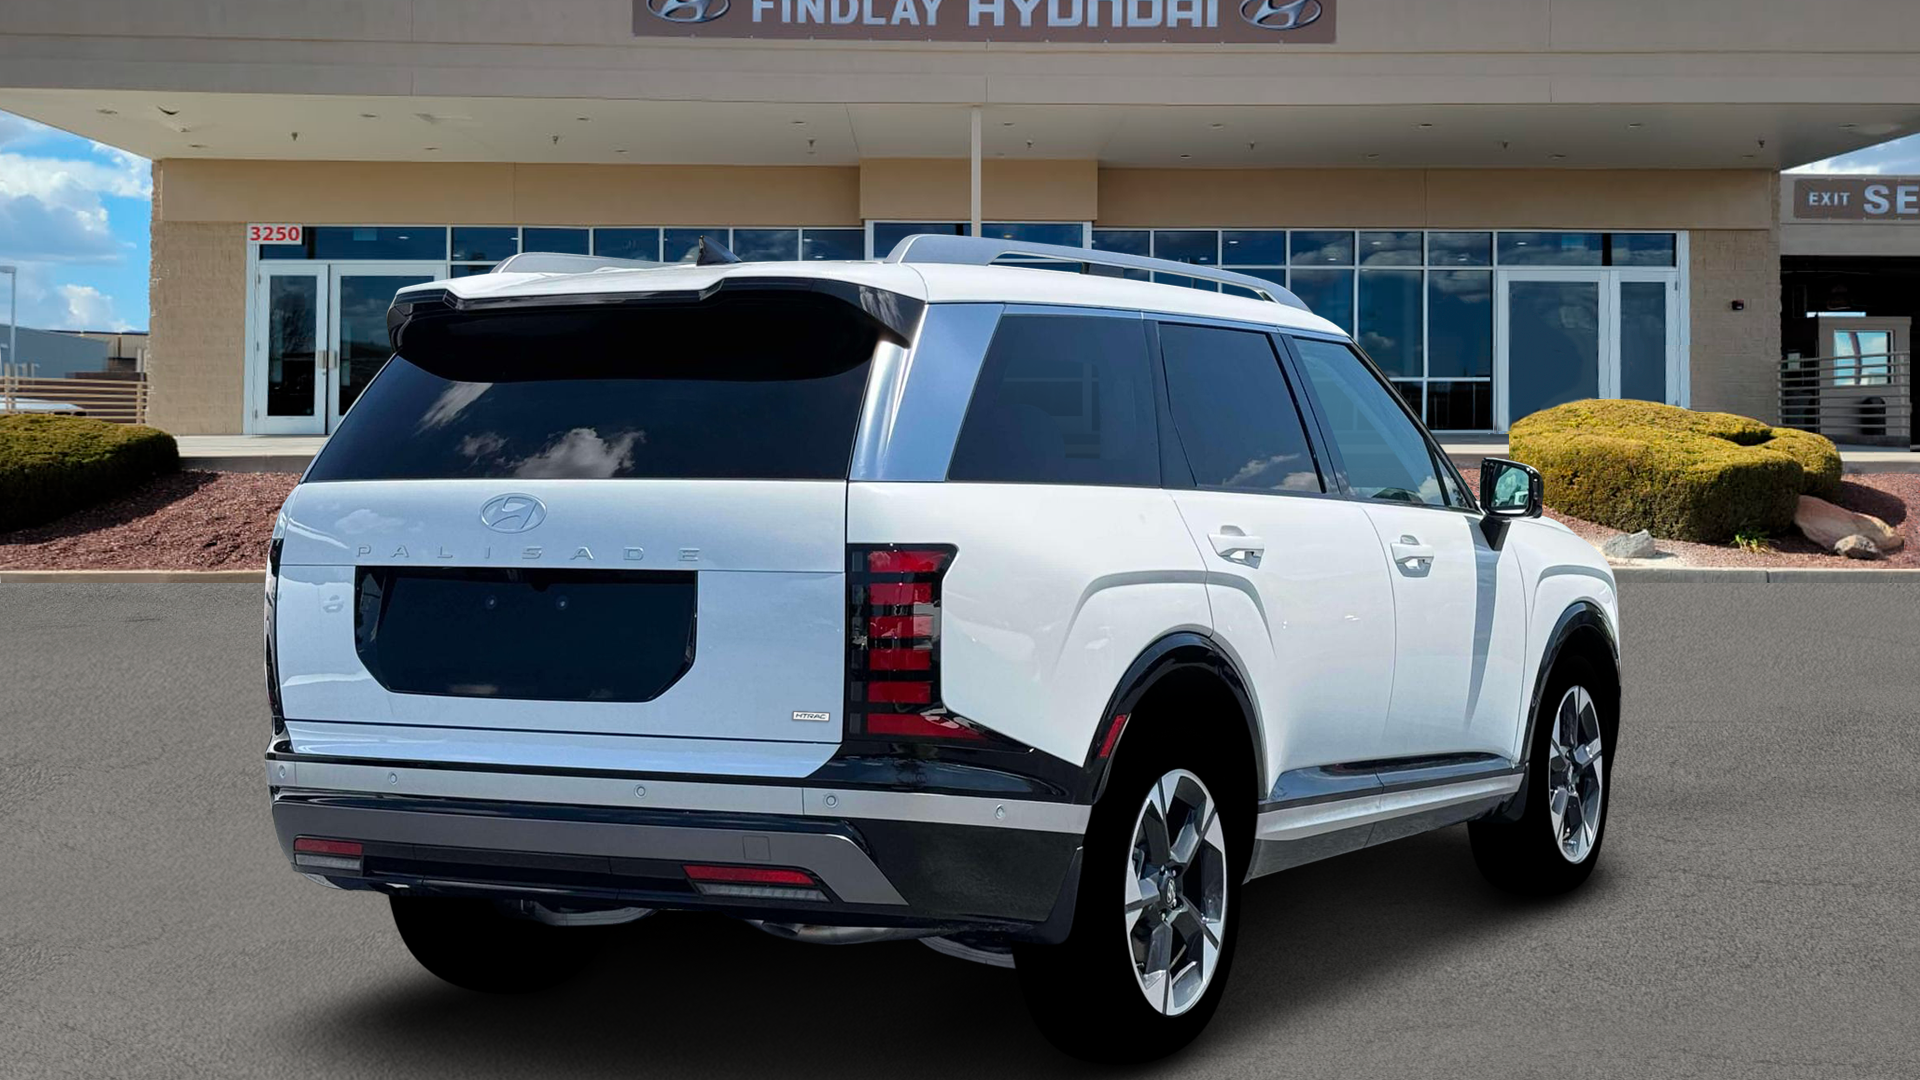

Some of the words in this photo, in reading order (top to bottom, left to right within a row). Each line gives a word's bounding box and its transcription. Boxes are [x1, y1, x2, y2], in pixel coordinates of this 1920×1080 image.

[752, 0, 941, 26] FINDLAY
[967, 0, 1219, 28] HYUNDAI
[1808, 191, 1851, 207] EXIT
[1863, 184, 1920, 215] SE
[250, 226, 300, 241] 3250
[355, 545, 701, 562] PALISADE
[795, 712, 828, 720] HTRAC
